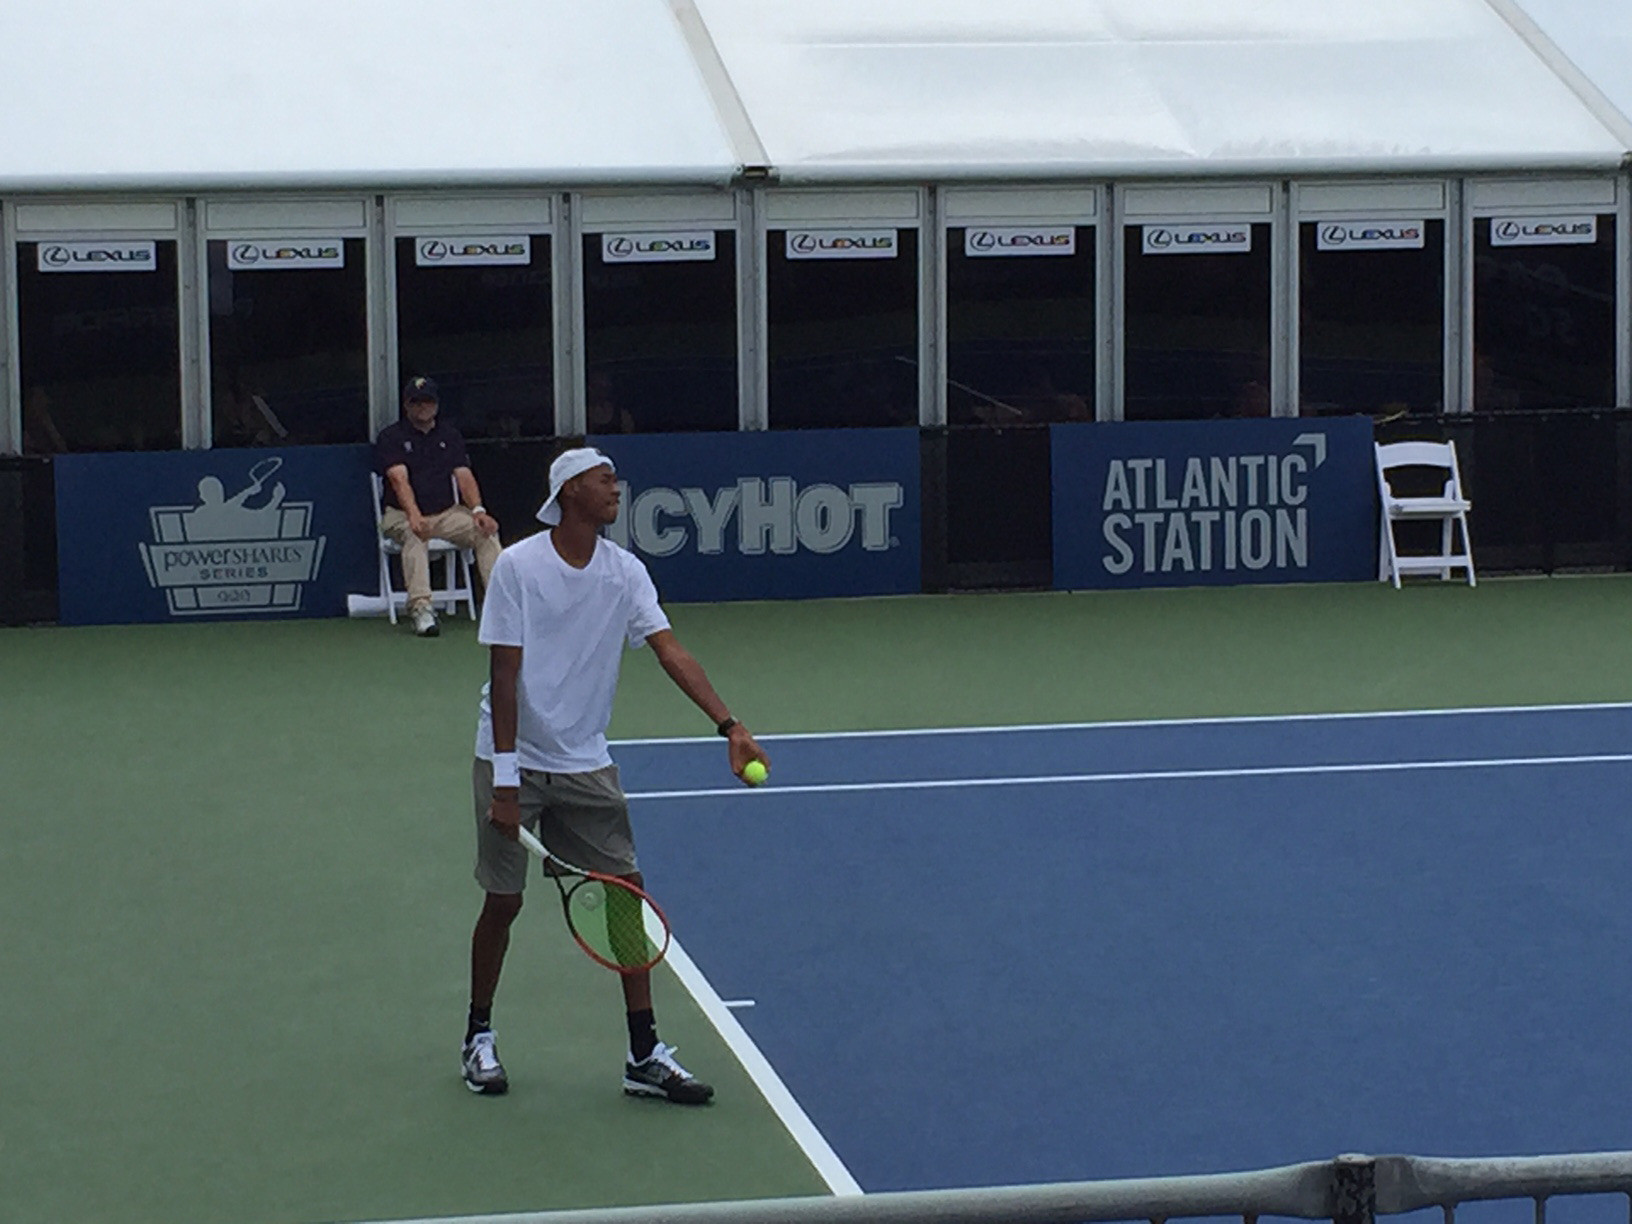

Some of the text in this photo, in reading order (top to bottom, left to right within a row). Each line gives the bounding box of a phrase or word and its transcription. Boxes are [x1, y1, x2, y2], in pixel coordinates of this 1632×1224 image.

[1348, 227, 1420, 241] LEXUS
[1521, 222, 1593, 236] LEXUS
[818, 236, 893, 249] LEXUS
[998, 233, 1070, 247] LEXUS
[1174, 230, 1246, 244] LEXUS
[448, 242, 525, 256] LEXUS
[634, 238, 711, 252] LEXUS
[72, 248, 151, 262] LEXUS
[262, 246, 339, 260] LEXUS
[1103, 453, 1307, 510] ATLANTIC
[1103, 508, 1307, 574] STATION
[200, 567, 269, 580] SERIES
